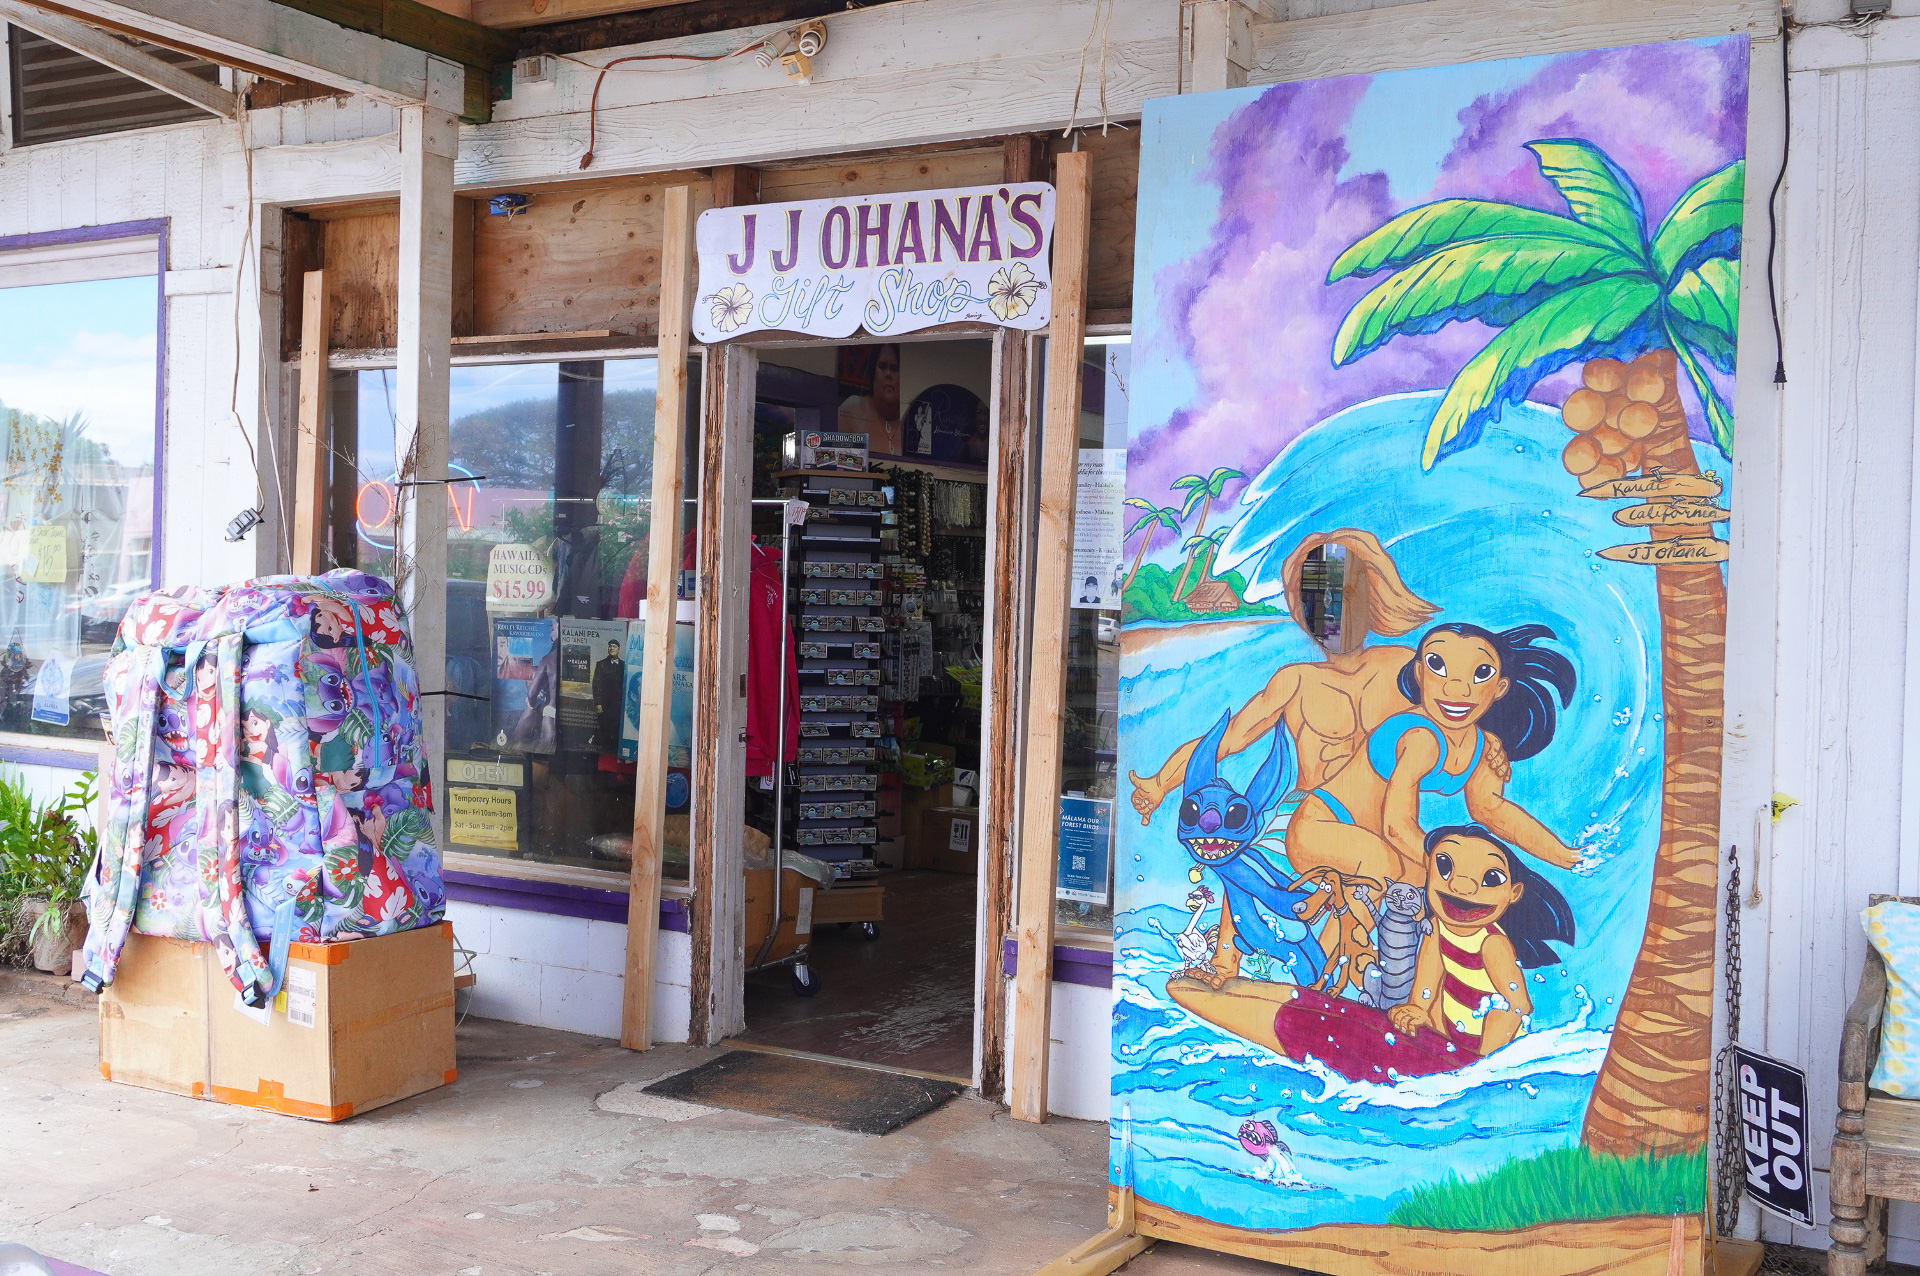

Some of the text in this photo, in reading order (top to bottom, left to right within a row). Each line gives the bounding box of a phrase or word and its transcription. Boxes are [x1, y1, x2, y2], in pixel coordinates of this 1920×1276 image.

[725, 187, 1045, 275] J J OHANA'S
[758, 267, 994, 333] Gift Shop
[493, 564, 548, 575] MUSIC CDs
[492, 580, 546, 599] $15.99
[562, 629, 586, 637] KALANI
[461, 763, 509, 782] OPEN
[453, 794, 512, 805] Temporary Hours
[500, 824, 514, 832] 2pm
[1739, 1064, 1770, 1194] KEEP
[1771, 1087, 1803, 1191] OUT
